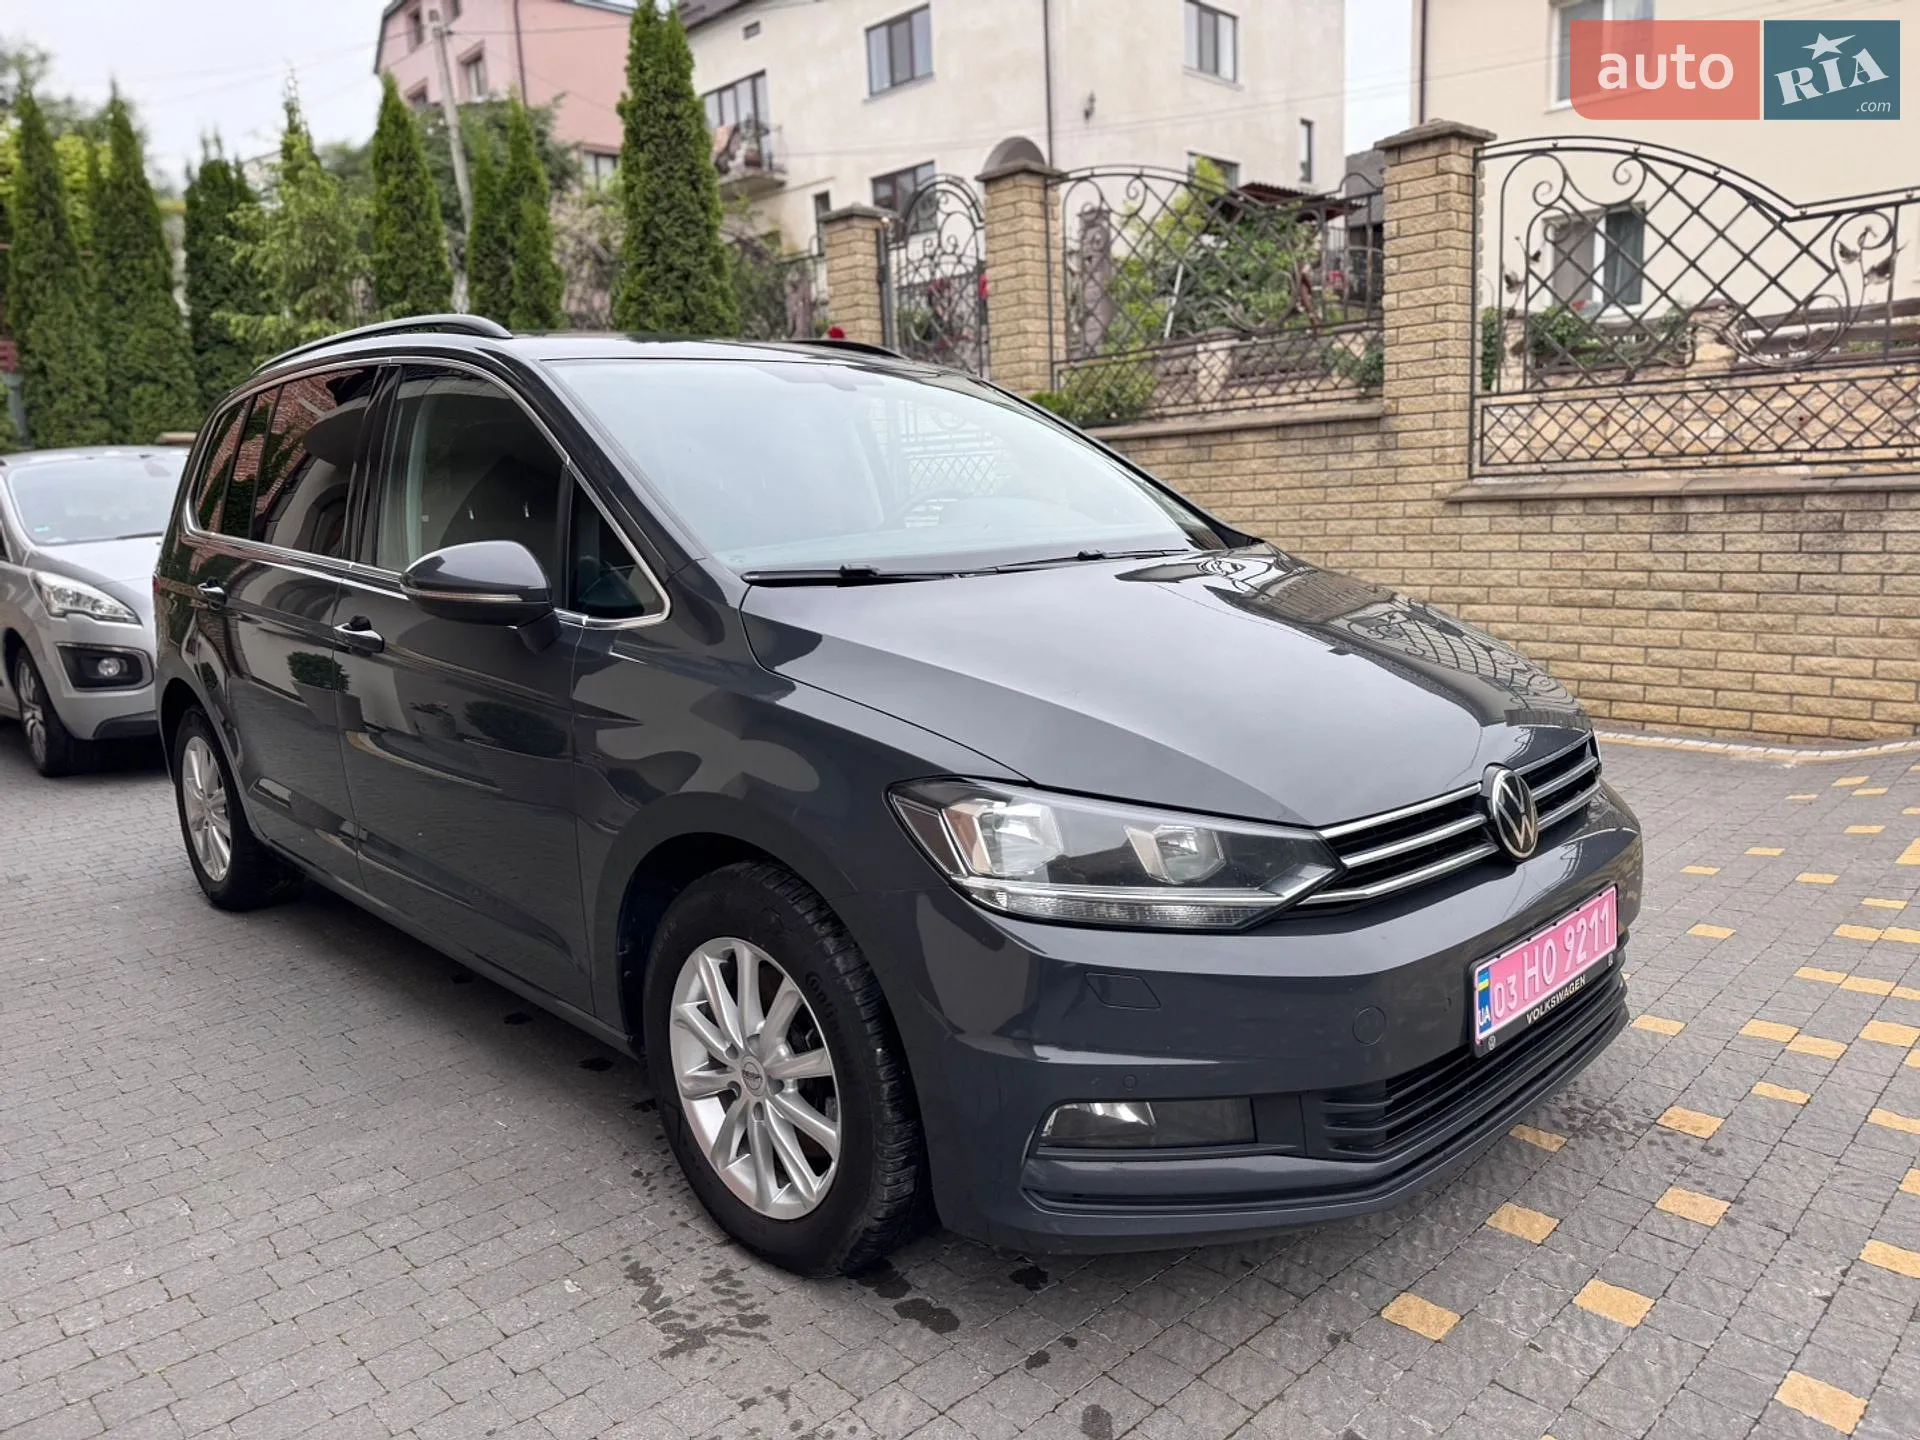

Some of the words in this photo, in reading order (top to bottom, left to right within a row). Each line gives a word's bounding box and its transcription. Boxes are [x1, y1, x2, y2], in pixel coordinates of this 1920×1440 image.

[1494, 973, 1518, 1018] 03
[1522, 938, 1557, 1000] HO
[1563, 900, 1610, 973] 9211
[1478, 1005, 1491, 1026] UA
[1526, 975, 1586, 1024] VOLKSWAGEN
